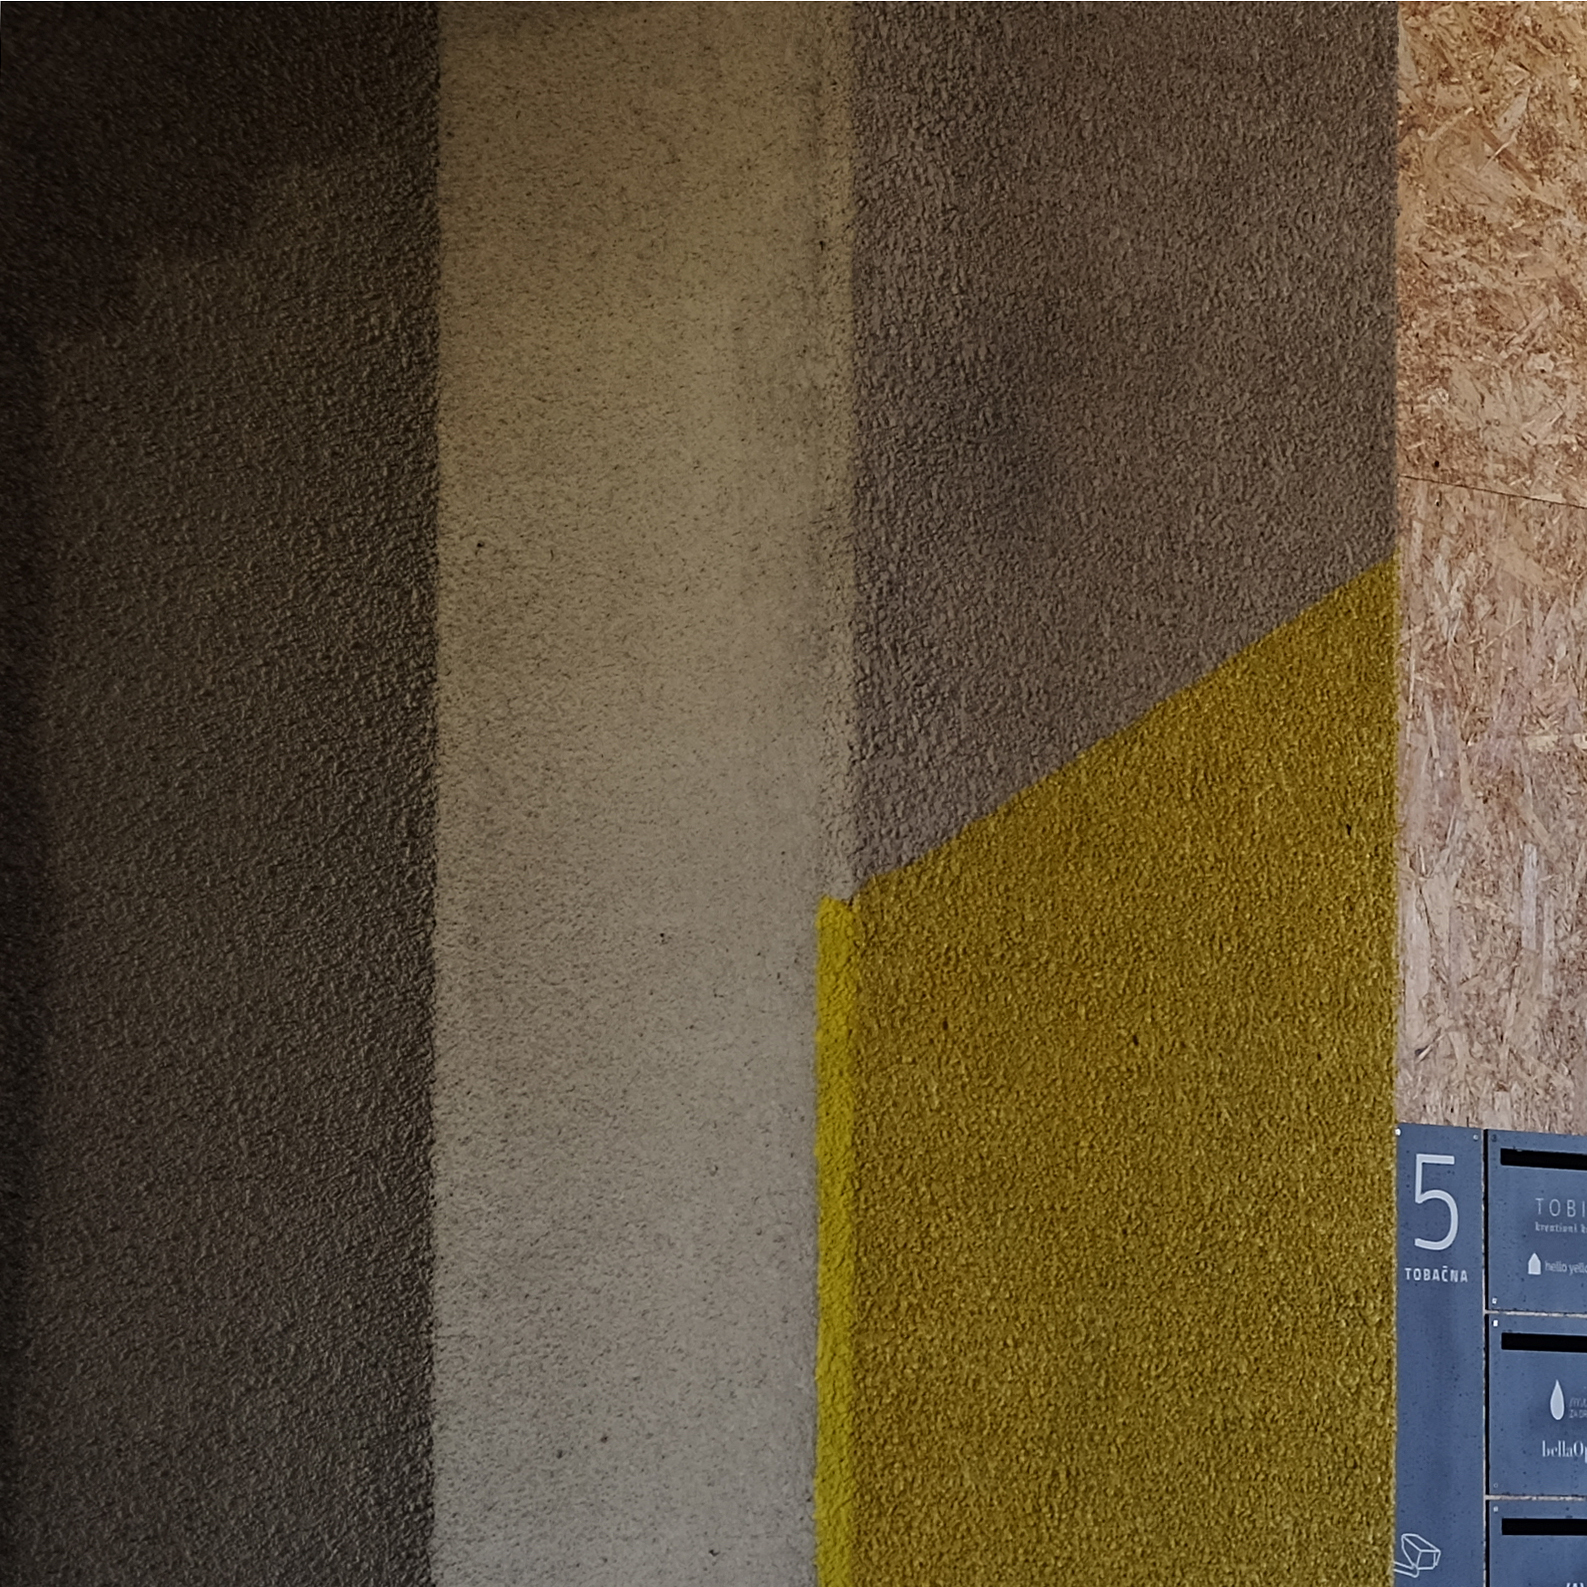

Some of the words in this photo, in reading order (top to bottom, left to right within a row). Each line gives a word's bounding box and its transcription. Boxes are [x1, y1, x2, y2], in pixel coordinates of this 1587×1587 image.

[1414, 1153, 1459, 1251] 5
[1404, 1265, 1469, 1283] TOBAČNA
[1545, 1260, 1568, 1273] hello
